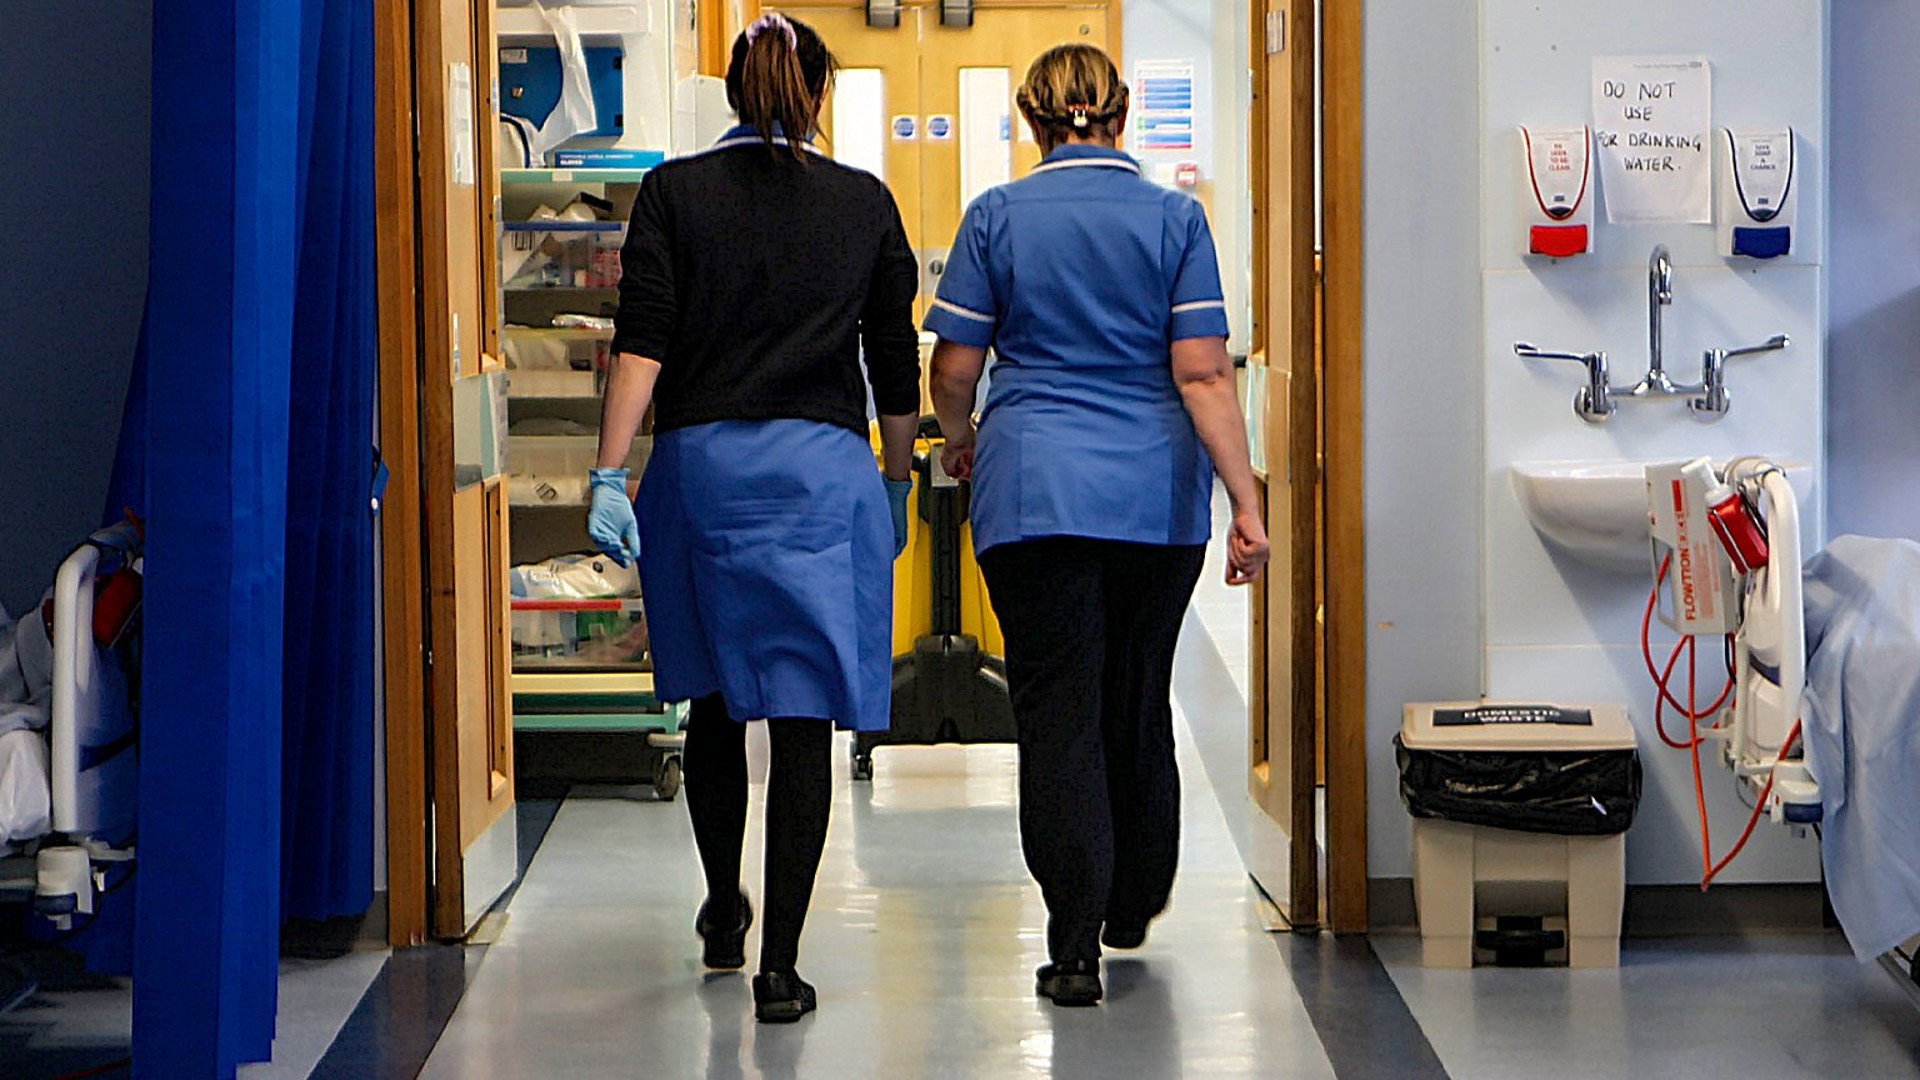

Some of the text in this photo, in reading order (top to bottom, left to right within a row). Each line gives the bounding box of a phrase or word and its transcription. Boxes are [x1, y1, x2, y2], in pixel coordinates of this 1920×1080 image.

[1604, 80, 1676, 100] DO NOT
[1624, 105, 1652, 121] USE
[1597, 131, 1701, 152] FOR DRINKING
